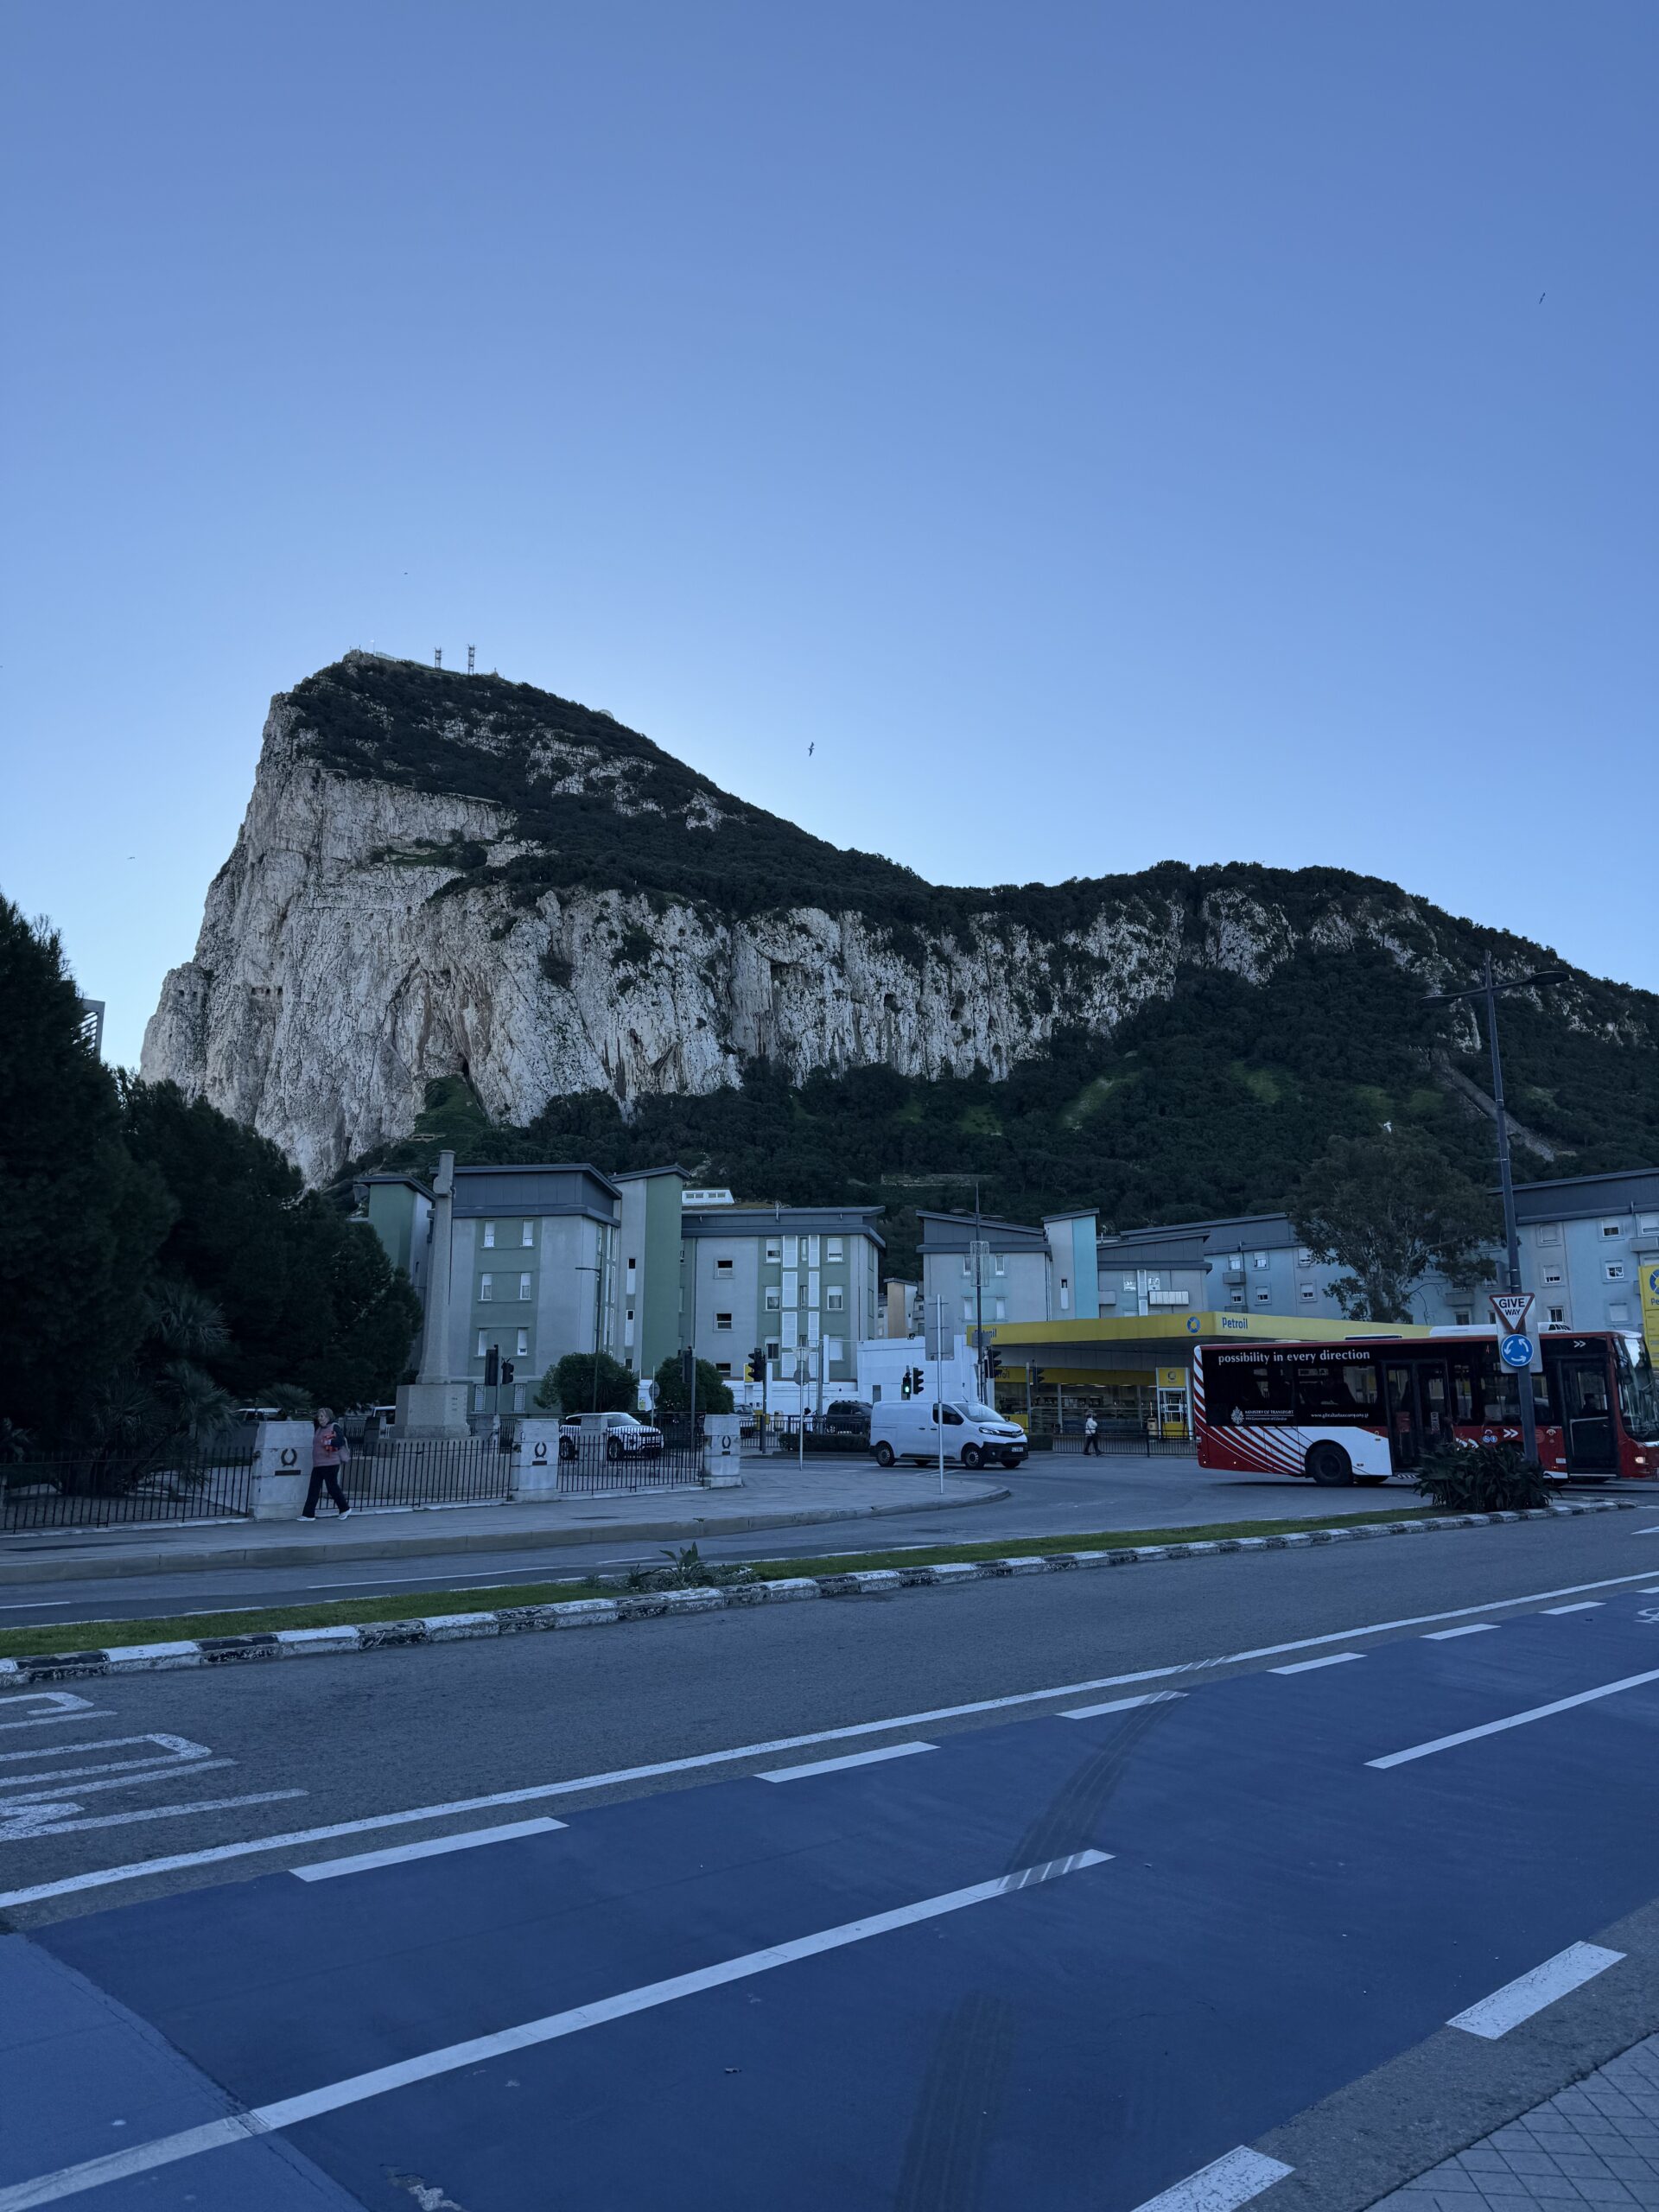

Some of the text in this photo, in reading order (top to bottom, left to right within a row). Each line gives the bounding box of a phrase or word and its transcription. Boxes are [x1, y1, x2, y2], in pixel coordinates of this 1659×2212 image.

[1499, 1298, 1525, 1308] GIVE
[1222, 1317, 1249, 1329] Petroil
[1218, 1350, 1371, 1365] possibility in every direction
